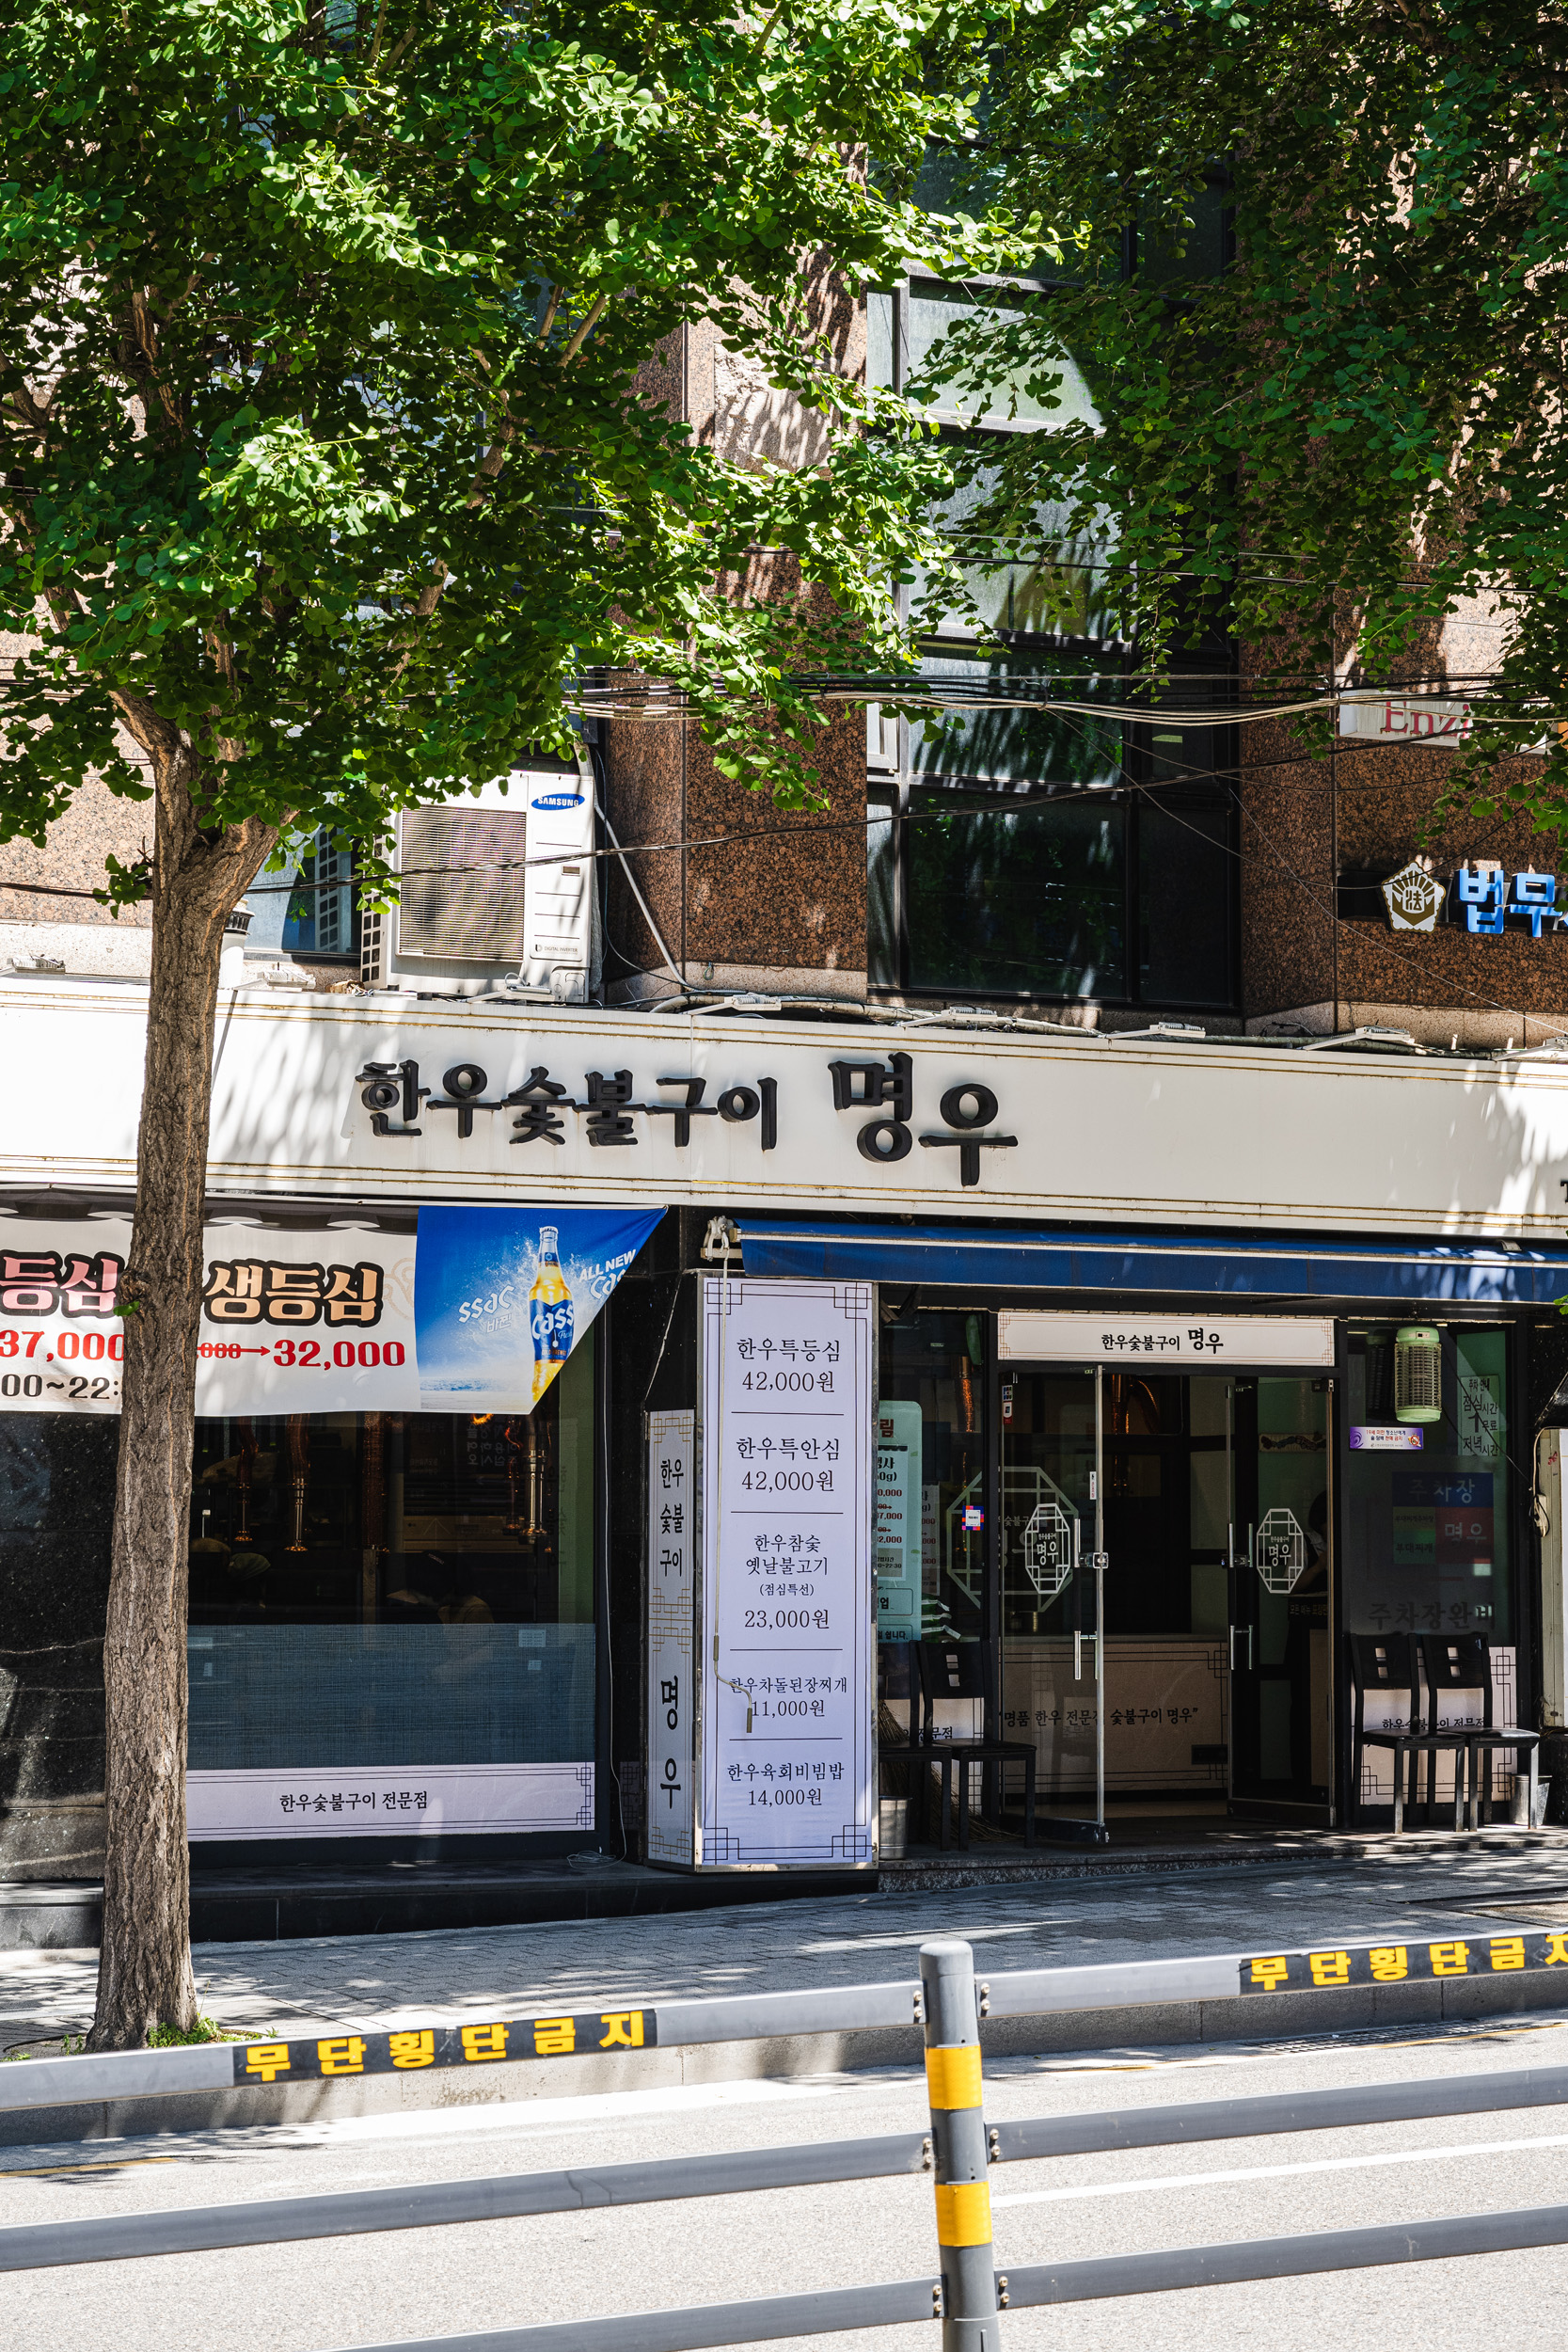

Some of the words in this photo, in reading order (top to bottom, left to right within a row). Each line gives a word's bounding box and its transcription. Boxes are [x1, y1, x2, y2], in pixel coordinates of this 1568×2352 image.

[538, 797, 579, 807] SAMSUNG
[1459, 868, 1568, 938] 법무
[355, 1058, 778, 1152] 한우숯불구이
[828, 1052, 1019, 1187] 명우
[578, 1263, 604, 1282] ALL
[605, 1249, 637, 1273] NEW
[204, 1261, 381, 1324] 생등심
[736, 1338, 840, 1362] 한우특등심
[1101, 1334, 1180, 1351] 한우숯불구이
[1188, 1327, 1224, 1354] 명우
[274, 1340, 404, 1371] 32,000
[742, 1371, 835, 1393] 42,000원
[736, 1438, 840, 1461] 한우특안심
[660, 1459, 684, 1488] 한우
[741, 1470, 834, 1493] 42,000원
[660, 1503, 684, 1534] 숯불
[754, 1534, 821, 1552] 한우참숯
[1037, 1541, 1059, 1565] 명우
[660, 1549, 682, 1577] 구이
[746, 1557, 829, 1576] 옛날불고기
[1269, 1544, 1291, 1566] 명우
[759, 1582, 815, 1597] (점심특선)
[744, 1609, 831, 1629] 23,000원
[730, 1677, 847, 1693] 한우차돌된장찌개
[752, 1699, 826, 1717] 11,000원
[1035, 1710, 1061, 1726] 한우
[1110, 1708, 1163, 1725] 숯불구이
[660, 1676, 681, 1809] 명우
[727, 1762, 845, 1781] 한우육회비빔밥
[279, 1792, 375, 1812] 한우숯불구이
[382, 1790, 427, 1809] 전문점
[748, 1788, 823, 1806] 14,000원
